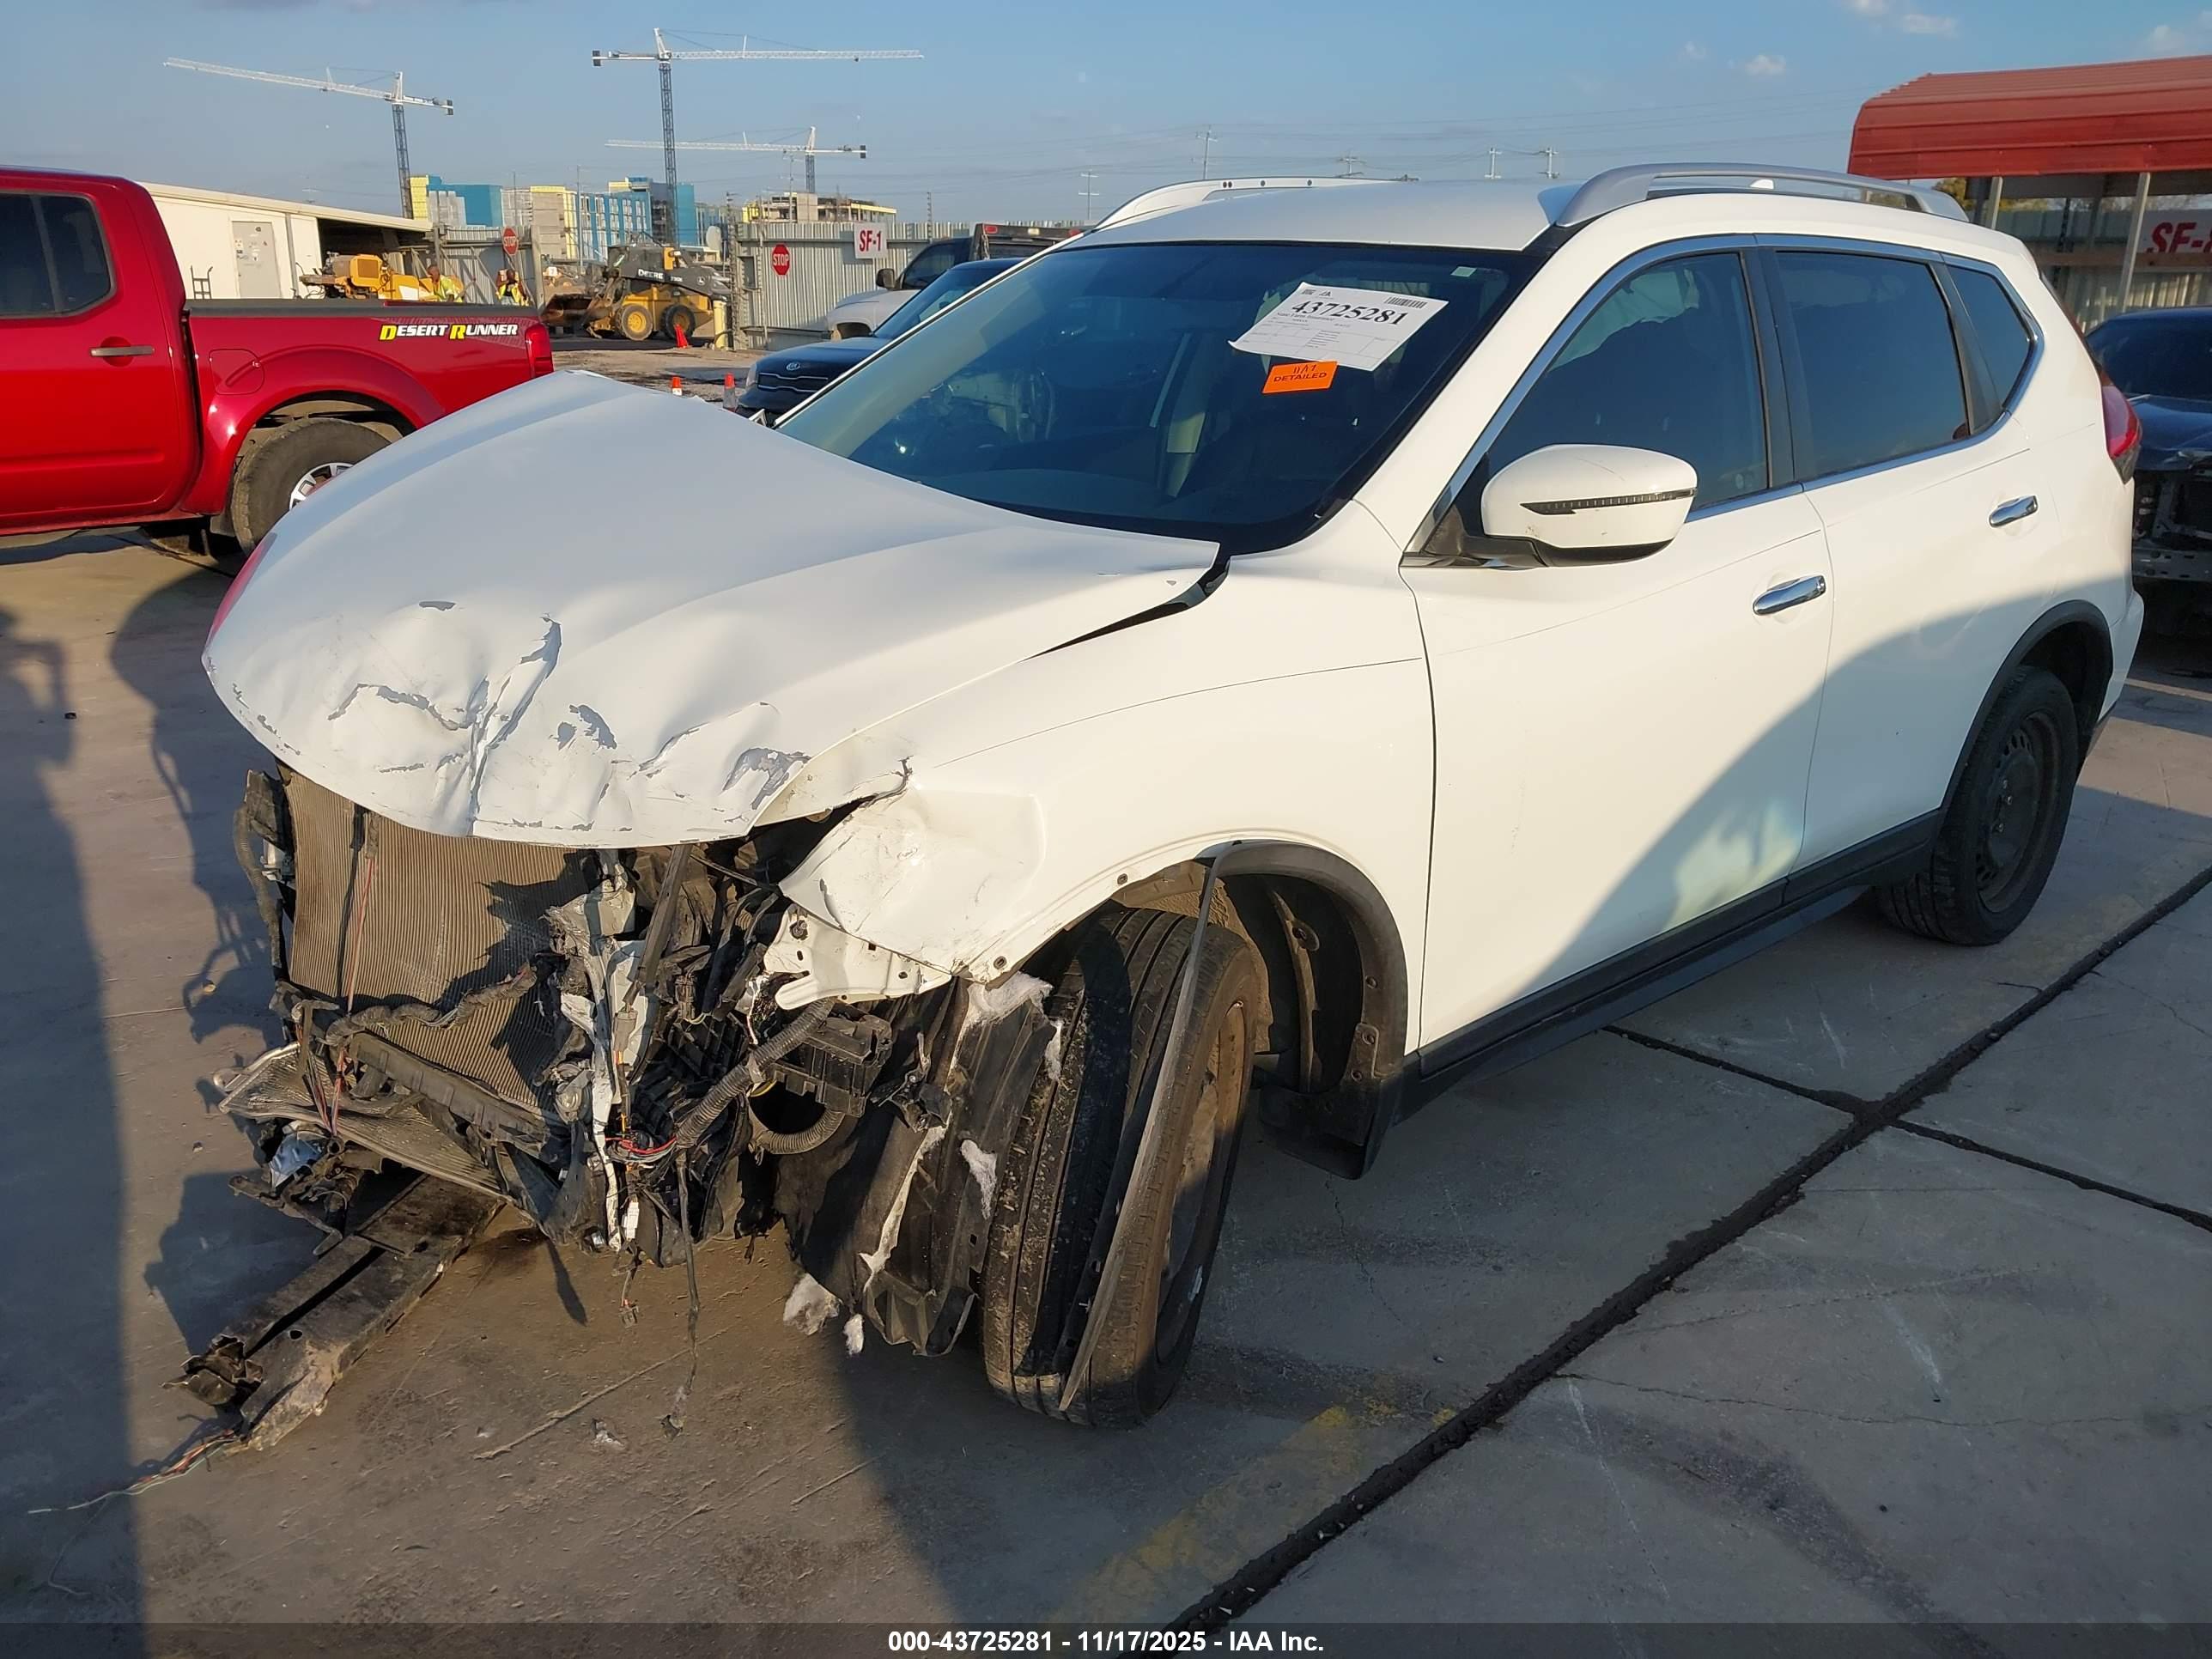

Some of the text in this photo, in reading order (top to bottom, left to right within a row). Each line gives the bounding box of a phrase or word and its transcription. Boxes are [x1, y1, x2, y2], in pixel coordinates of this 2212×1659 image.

[859, 230, 882, 252] SF-1
[773, 253, 789, 266] STOP
[638, 268, 664, 280] DEERE
[1291, 301, 1408, 325] 43725281
[379, 324, 518, 341] DESERT RUNNER
[1273, 372, 1327, 382] DETAILED
